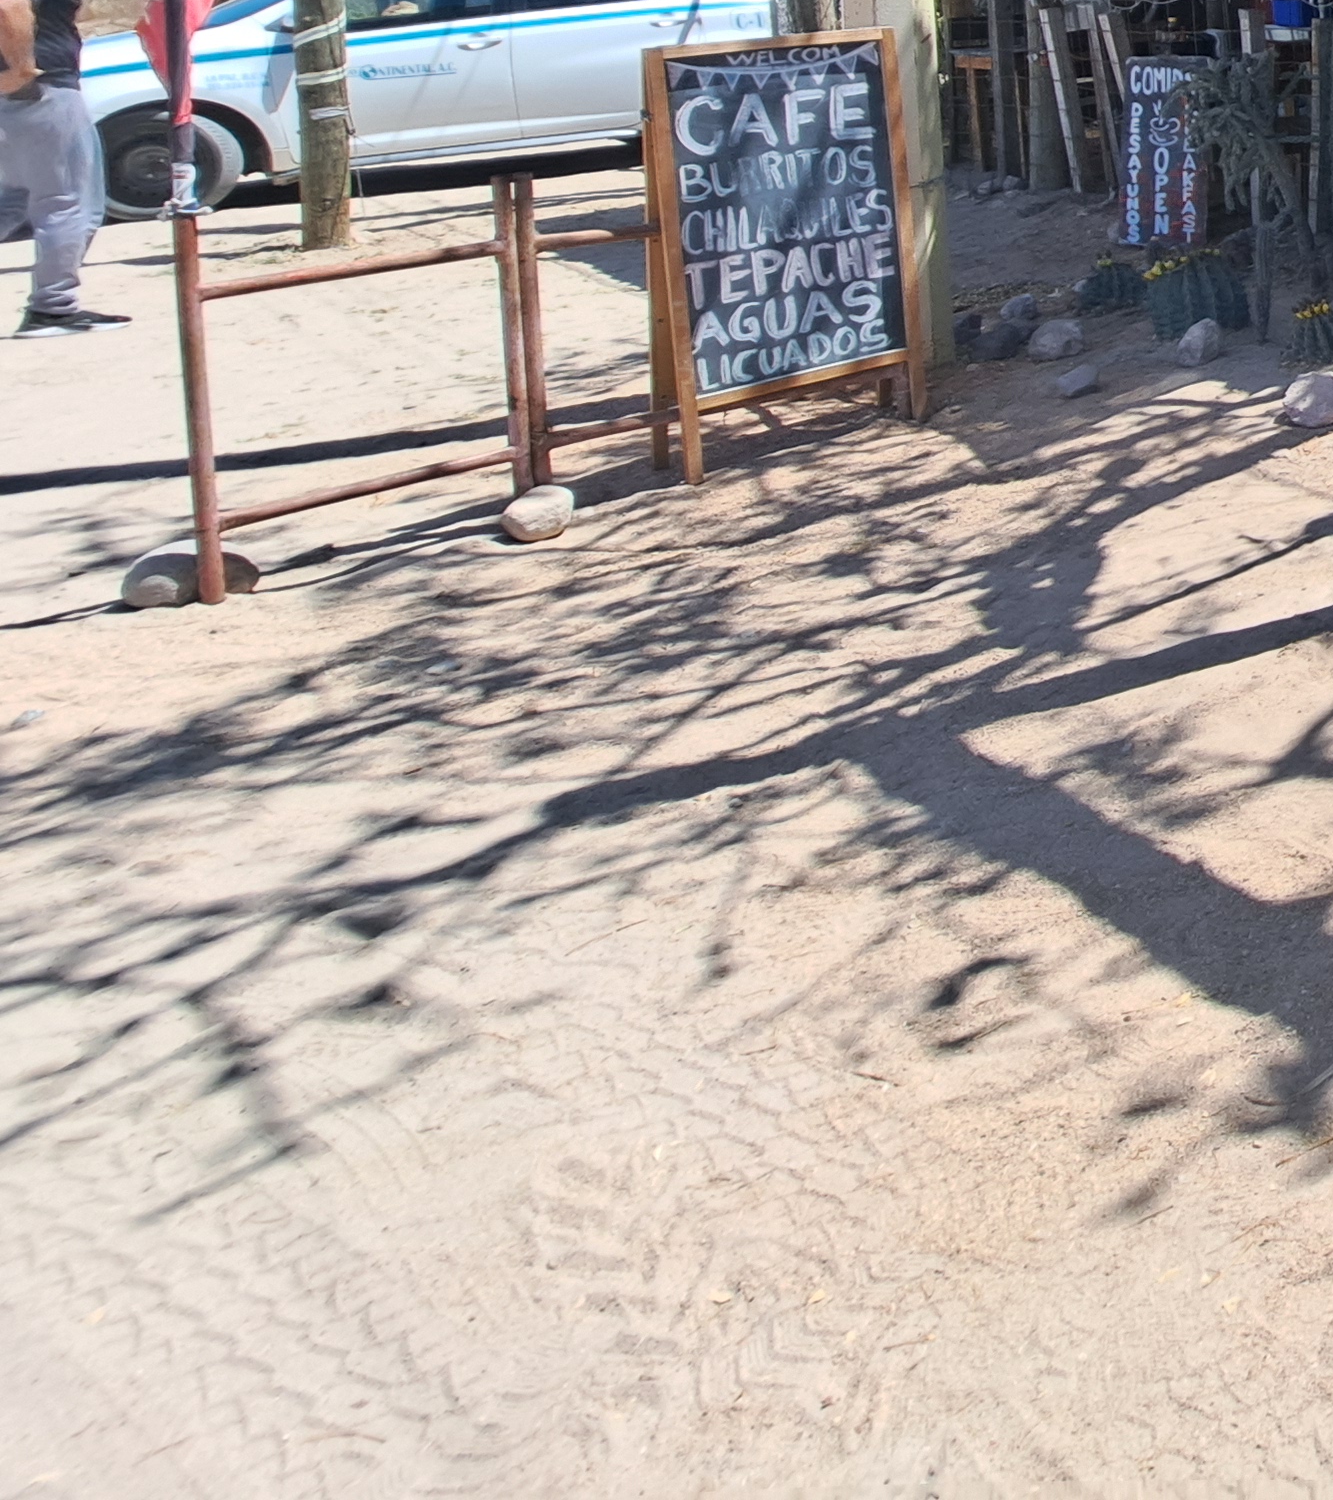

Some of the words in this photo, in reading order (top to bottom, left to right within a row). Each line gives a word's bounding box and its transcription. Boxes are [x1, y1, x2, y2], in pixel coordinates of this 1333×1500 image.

[1130, 65, 1193, 95] COMID
[675, 81, 876, 157] CAFE
[679, 145, 877, 203] BURRITOS
[1126, 102, 1143, 243] DESAYUNOS
[1153, 147, 1169, 235] OPEN
[681, 189, 894, 256] CHILAQUILES
[684, 233, 895, 310] TEPACHE
[691, 280, 883, 354] AGUAS
[697, 318, 891, 392] LICUADOS
